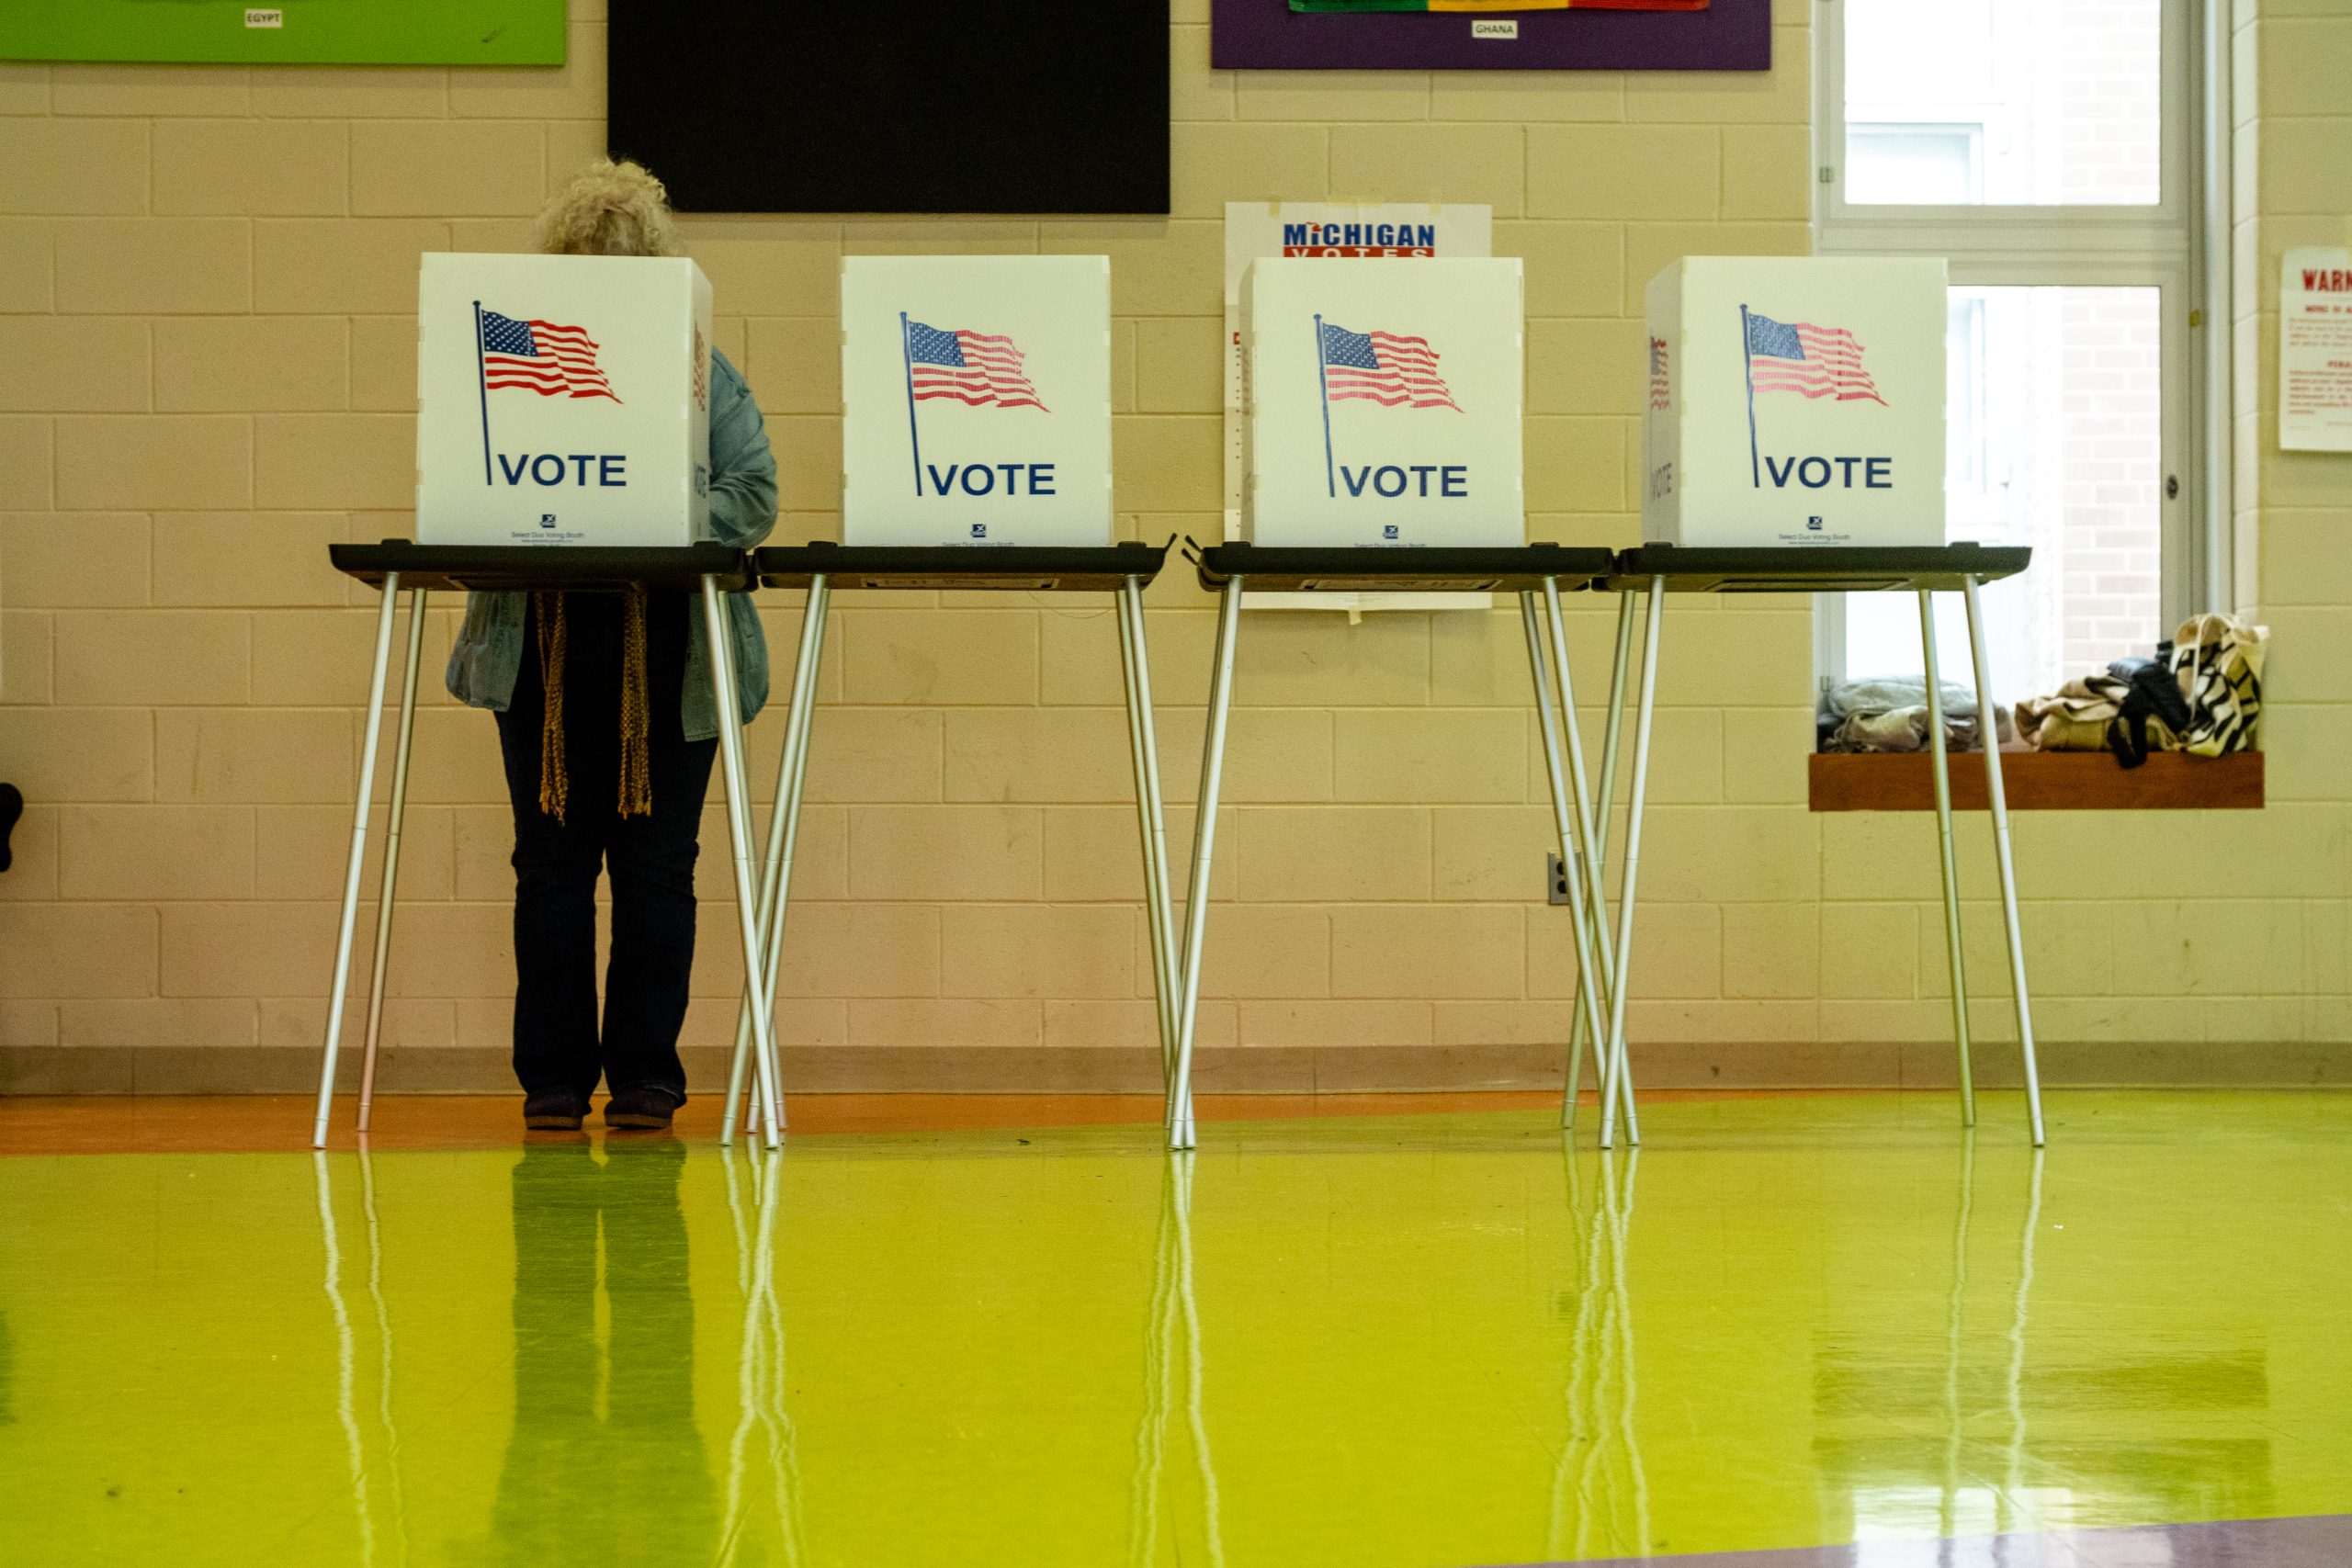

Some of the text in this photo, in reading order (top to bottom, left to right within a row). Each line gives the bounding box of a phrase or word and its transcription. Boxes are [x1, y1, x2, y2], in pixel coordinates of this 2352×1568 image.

[247, 13, 279, 23] EGYPT
[1476, 24, 1514, 34] GHANA
[497, 454, 627, 487] VOTE
[927, 463, 1056, 496] VOTE
[1340, 465, 1468, 498] VOTE
[1765, 456, 1893, 489] VOTE
